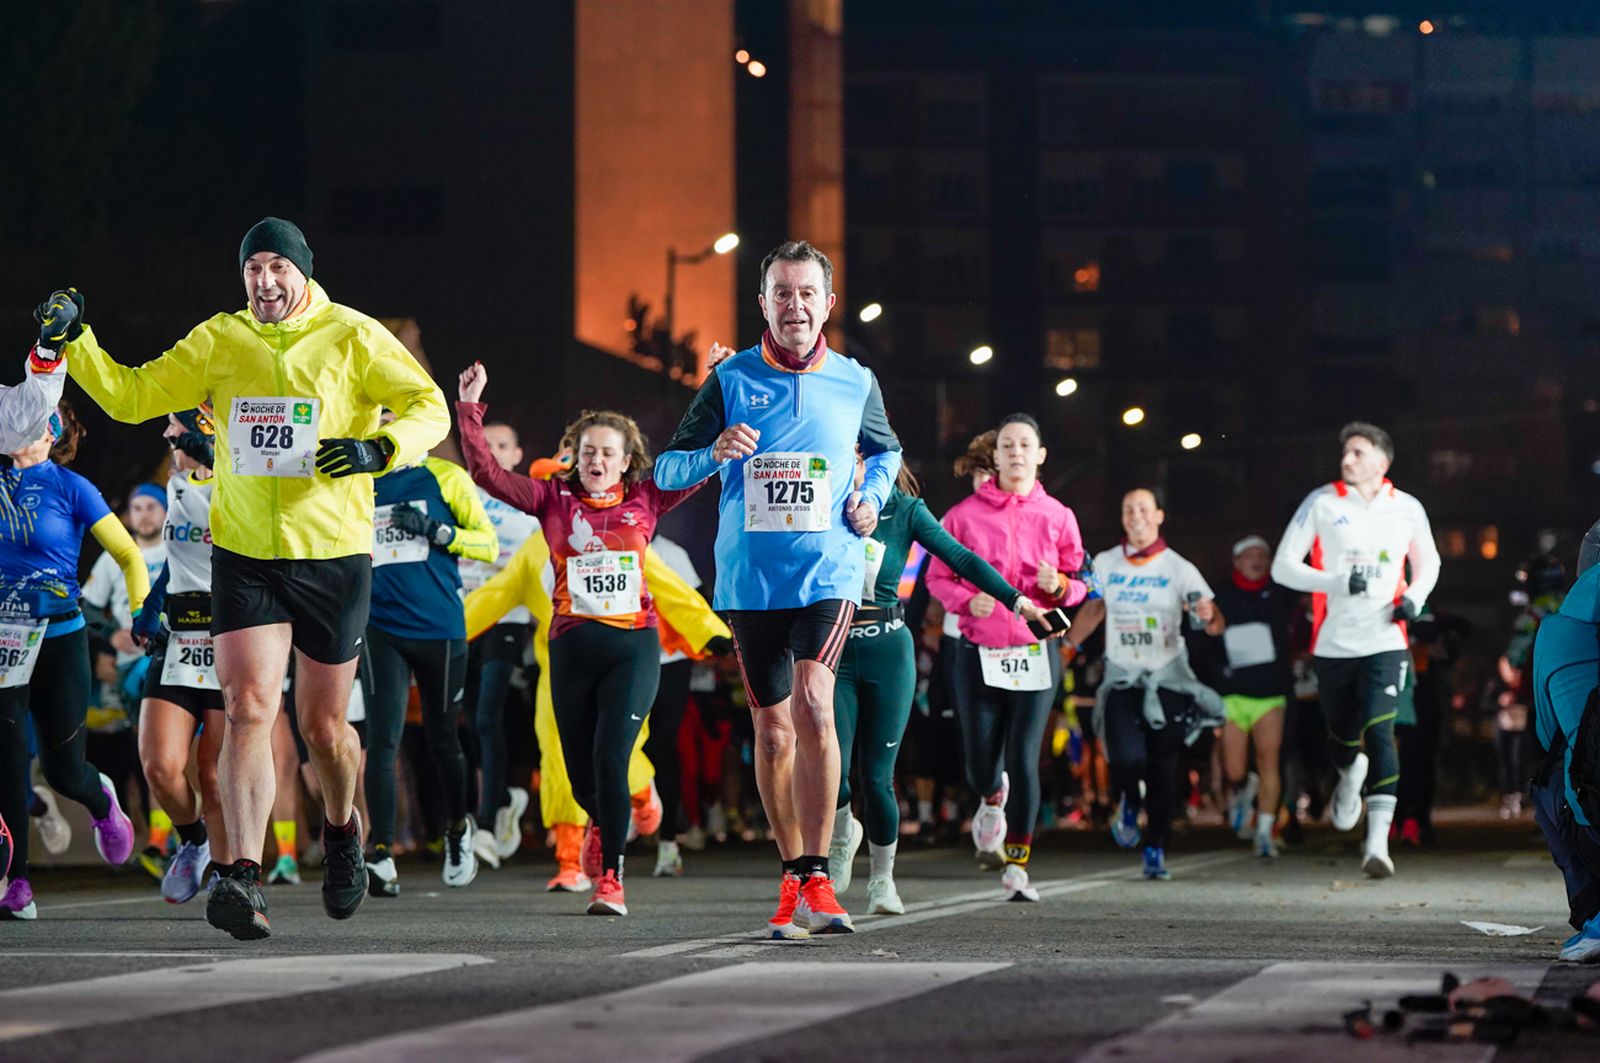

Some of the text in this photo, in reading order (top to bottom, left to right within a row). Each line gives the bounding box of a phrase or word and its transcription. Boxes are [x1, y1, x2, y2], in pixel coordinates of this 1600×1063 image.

[250, 405, 274, 413] NOCHE
[276, 405, 286, 413] DE
[239, 415, 256, 424] SAN
[257, 413, 285, 424] ANTÓN
[250, 425, 294, 449] 628
[763, 461, 789, 469] NOCHE
[791, 461, 801, 469] DE
[753, 470, 771, 480] SAN
[772, 468, 802, 480] ANTÓN
[764, 481, 814, 504] 1275
[583, 573, 627, 593] 1538
[1120, 632, 1153, 646] 6570
[1001, 658, 1029, 674] 574
